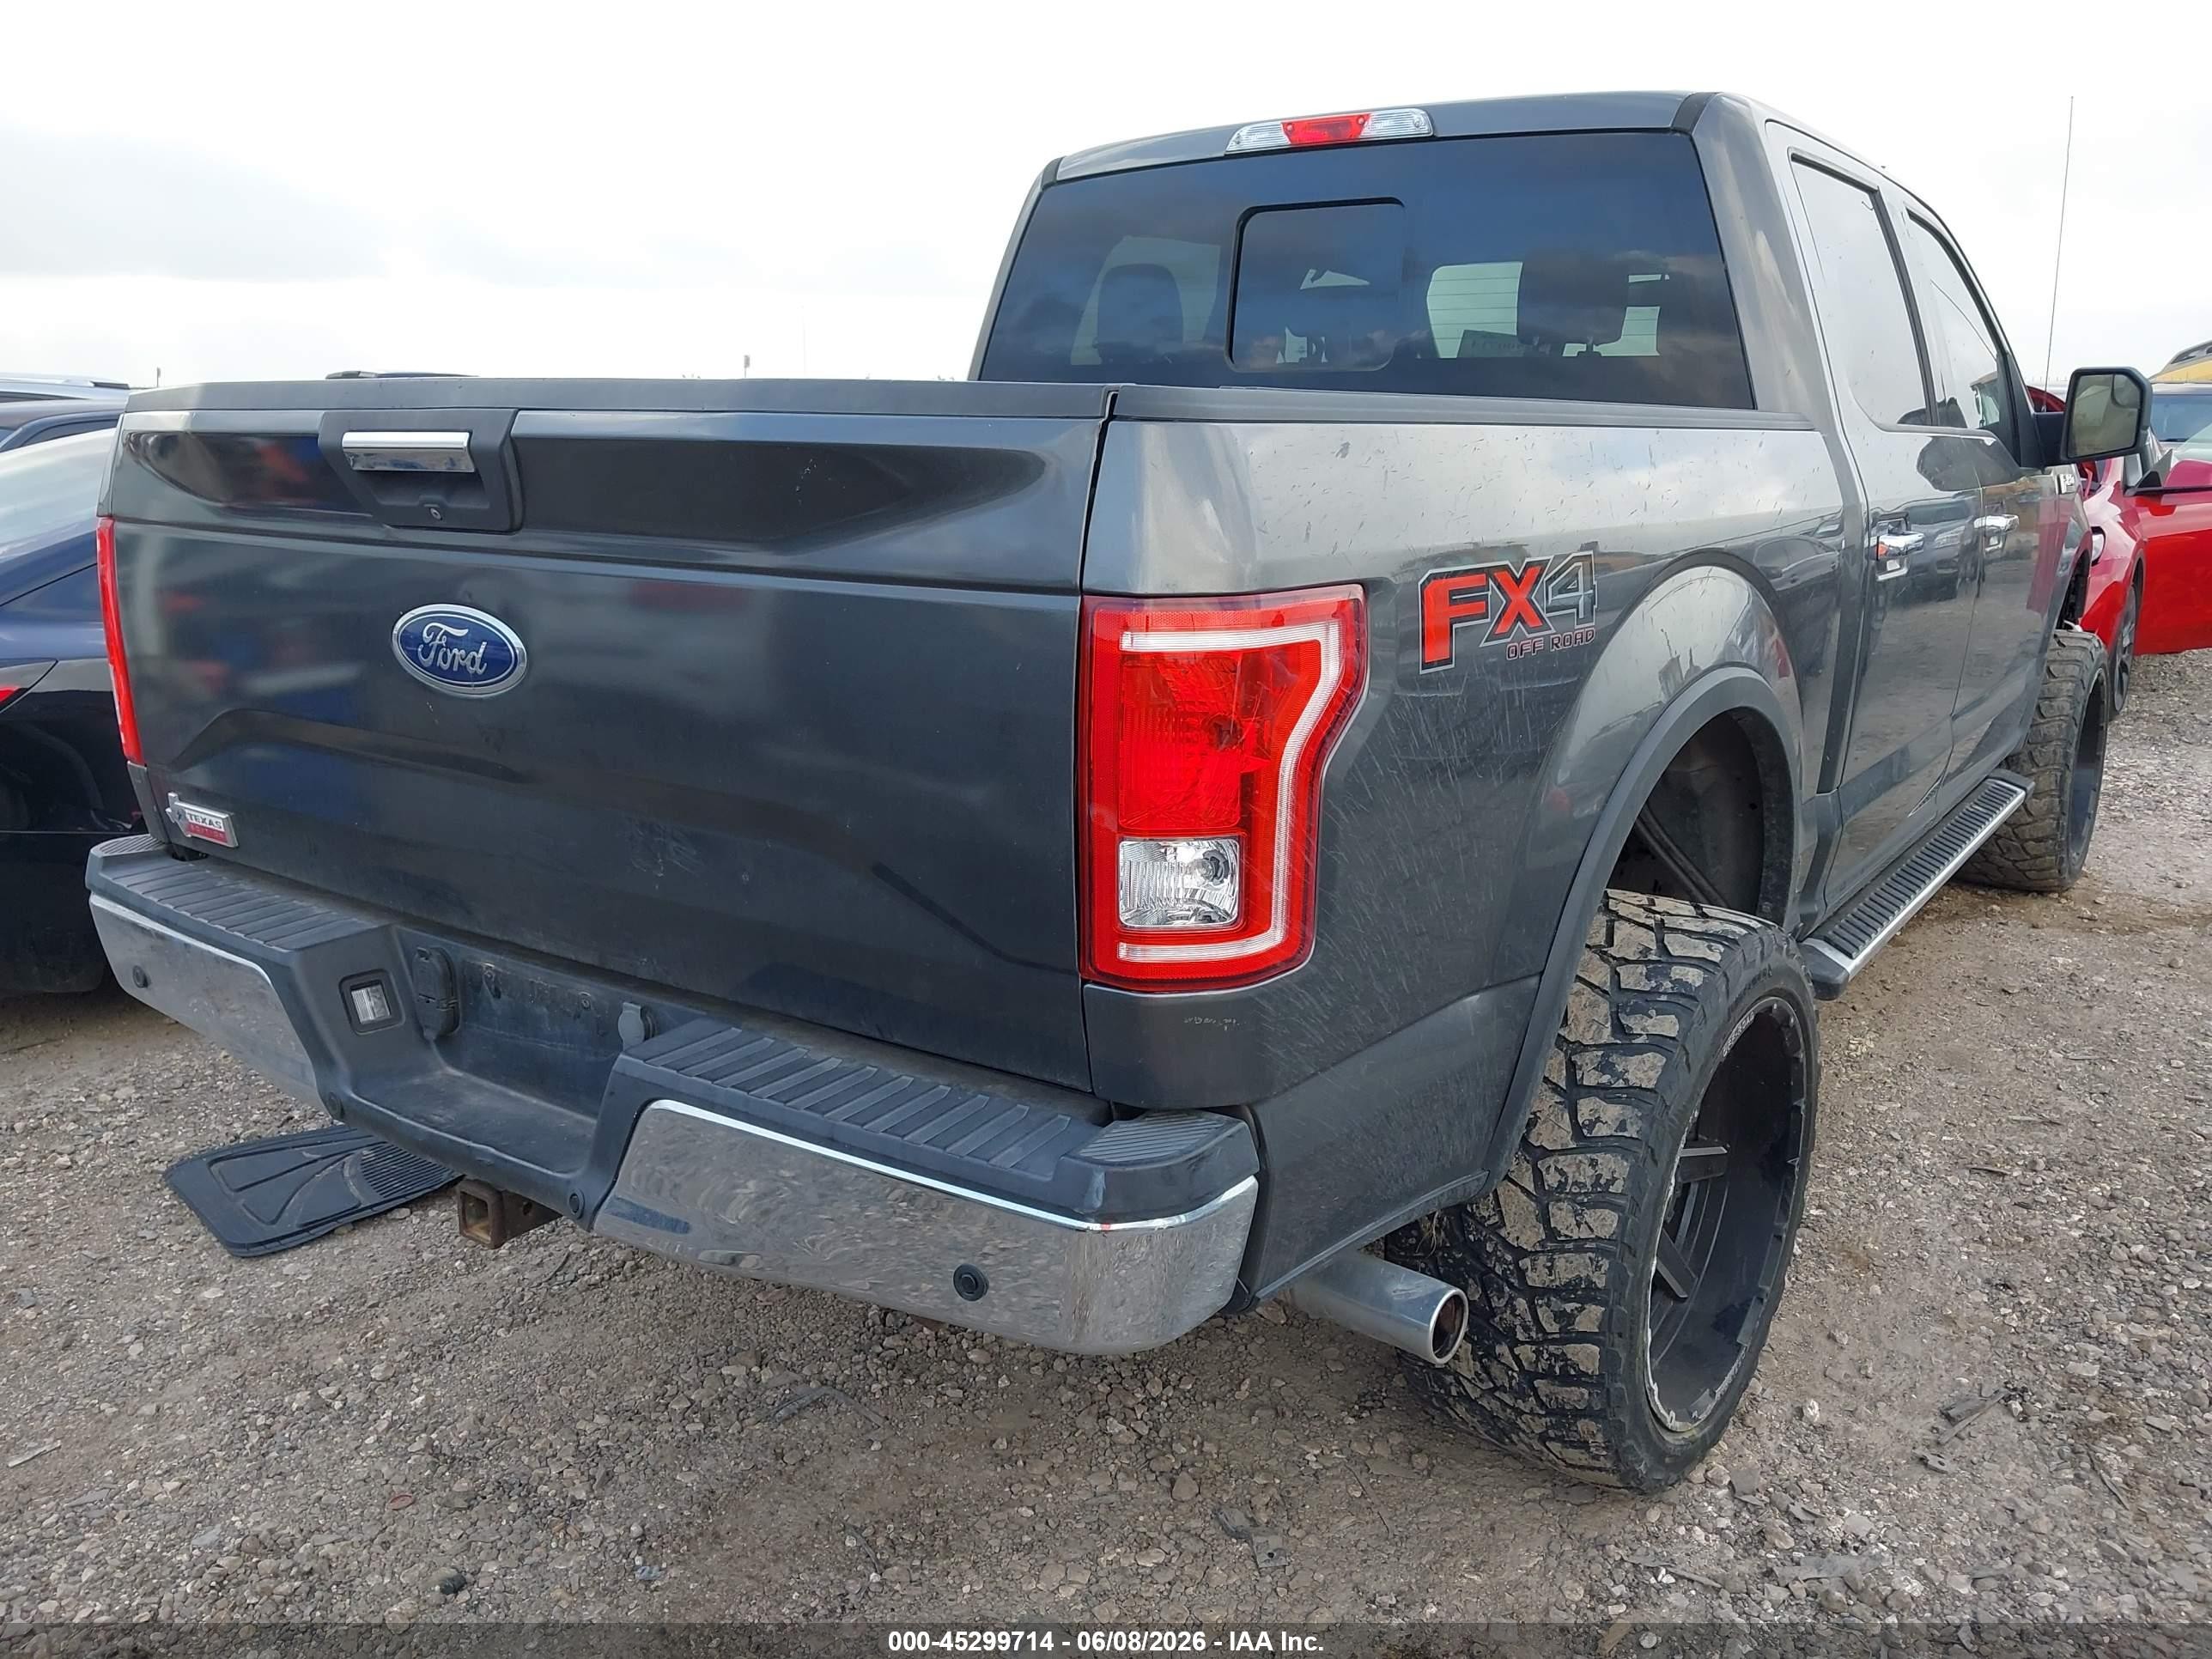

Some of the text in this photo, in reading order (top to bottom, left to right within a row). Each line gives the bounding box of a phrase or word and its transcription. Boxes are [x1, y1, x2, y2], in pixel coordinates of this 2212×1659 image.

[1419, 550, 1597, 675] FX4
[417, 622, 487, 675] Ford
[1506, 627, 1595, 660] OFF ROAD
[188, 813, 222, 830] TEXAS
